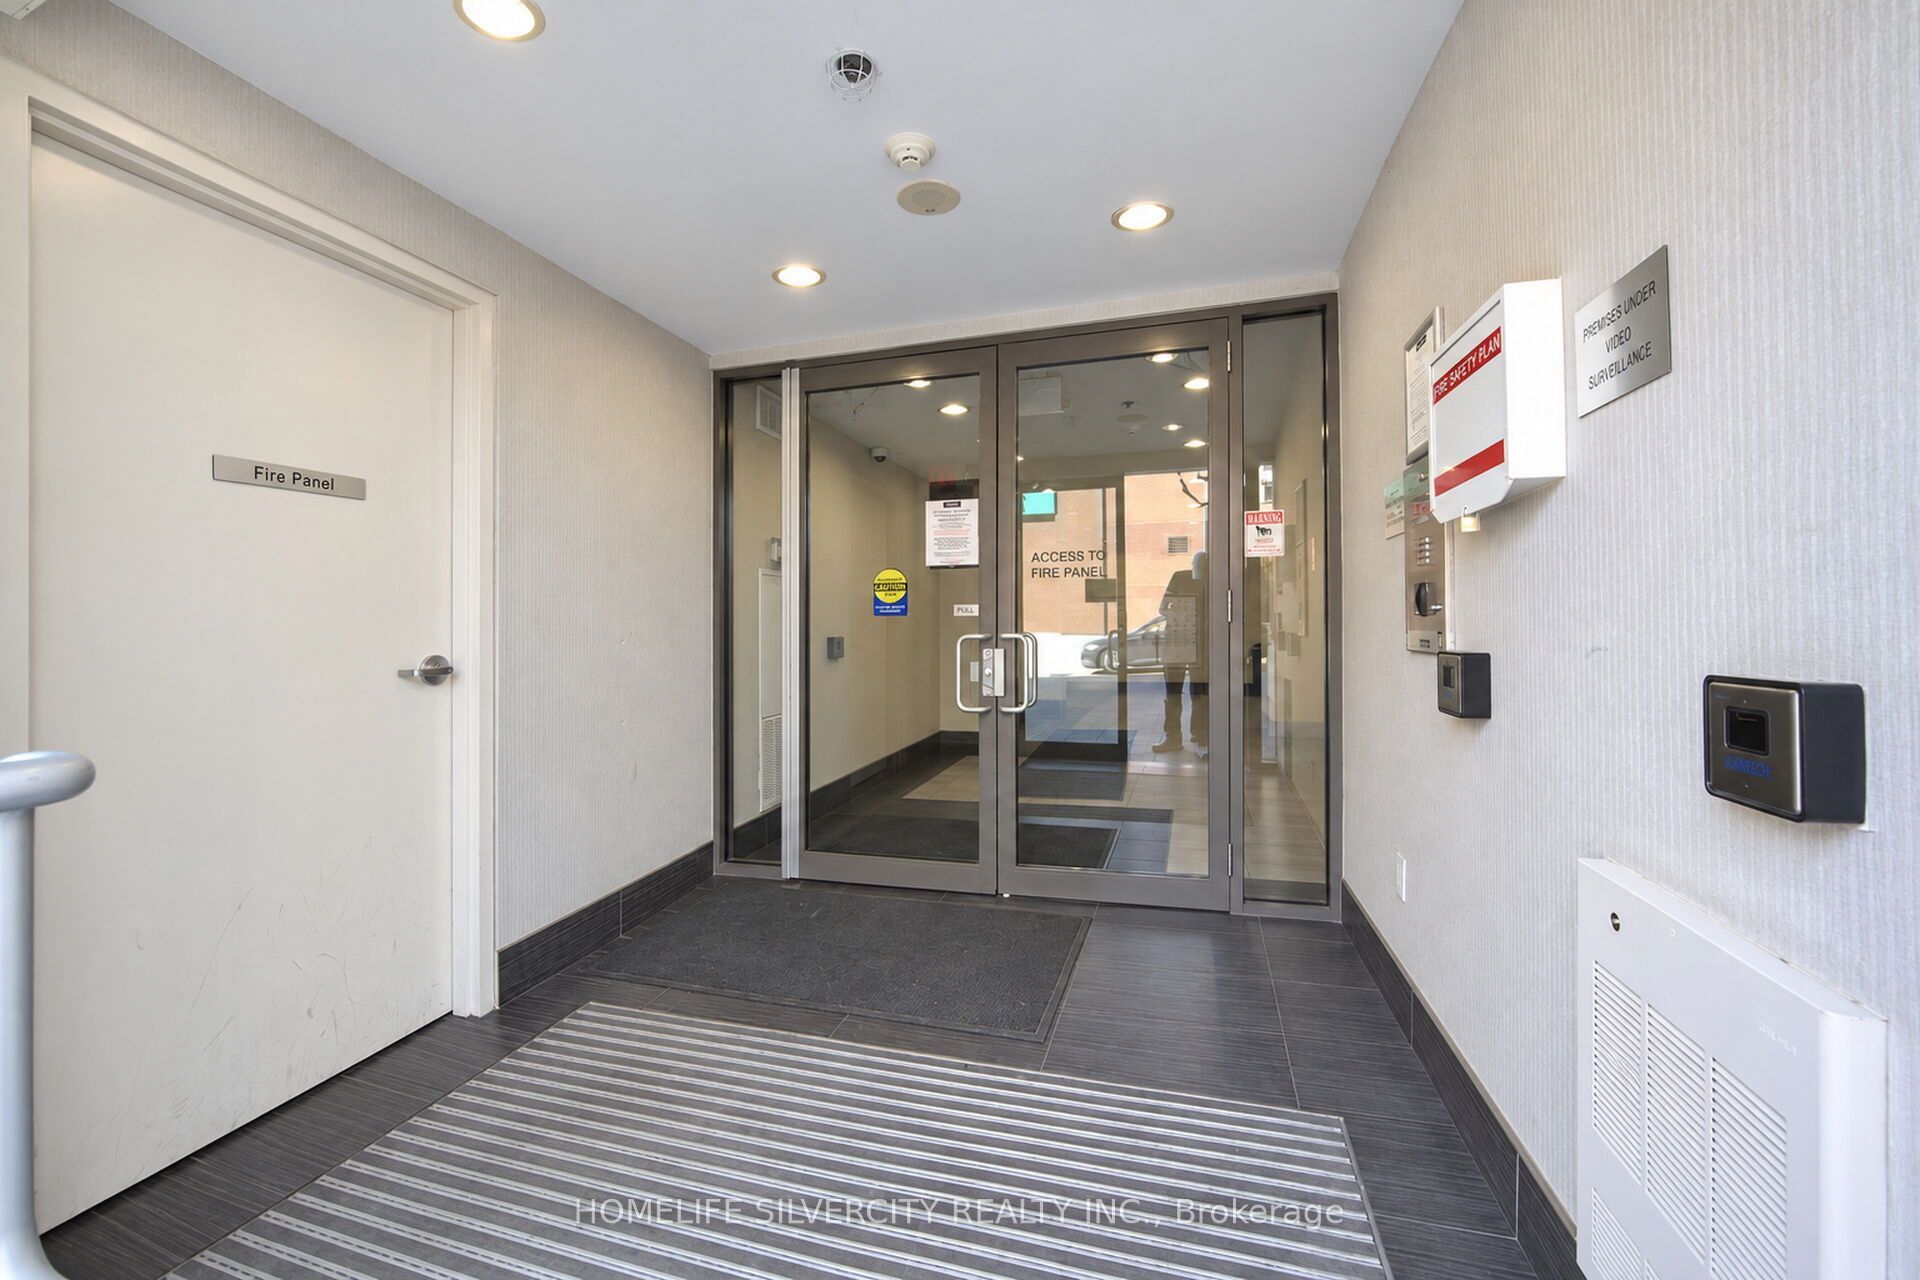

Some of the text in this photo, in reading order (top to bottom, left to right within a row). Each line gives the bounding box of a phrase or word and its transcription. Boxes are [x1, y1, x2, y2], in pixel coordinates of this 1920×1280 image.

[1583, 280, 1657, 343] PREMISES UNDER
[1605, 326, 1632, 353] VIDEO
[1433, 333, 1501, 401] FIRE SAFETY PLAN
[1588, 341, 1653, 390] SURVEILLANCE
[254, 465, 334, 490] Fire Panel
[1031, 550, 1106, 563] ACCESS TO
[1031, 566, 1107, 578] FIRE PANEL
[956, 606, 975, 614] PULL
